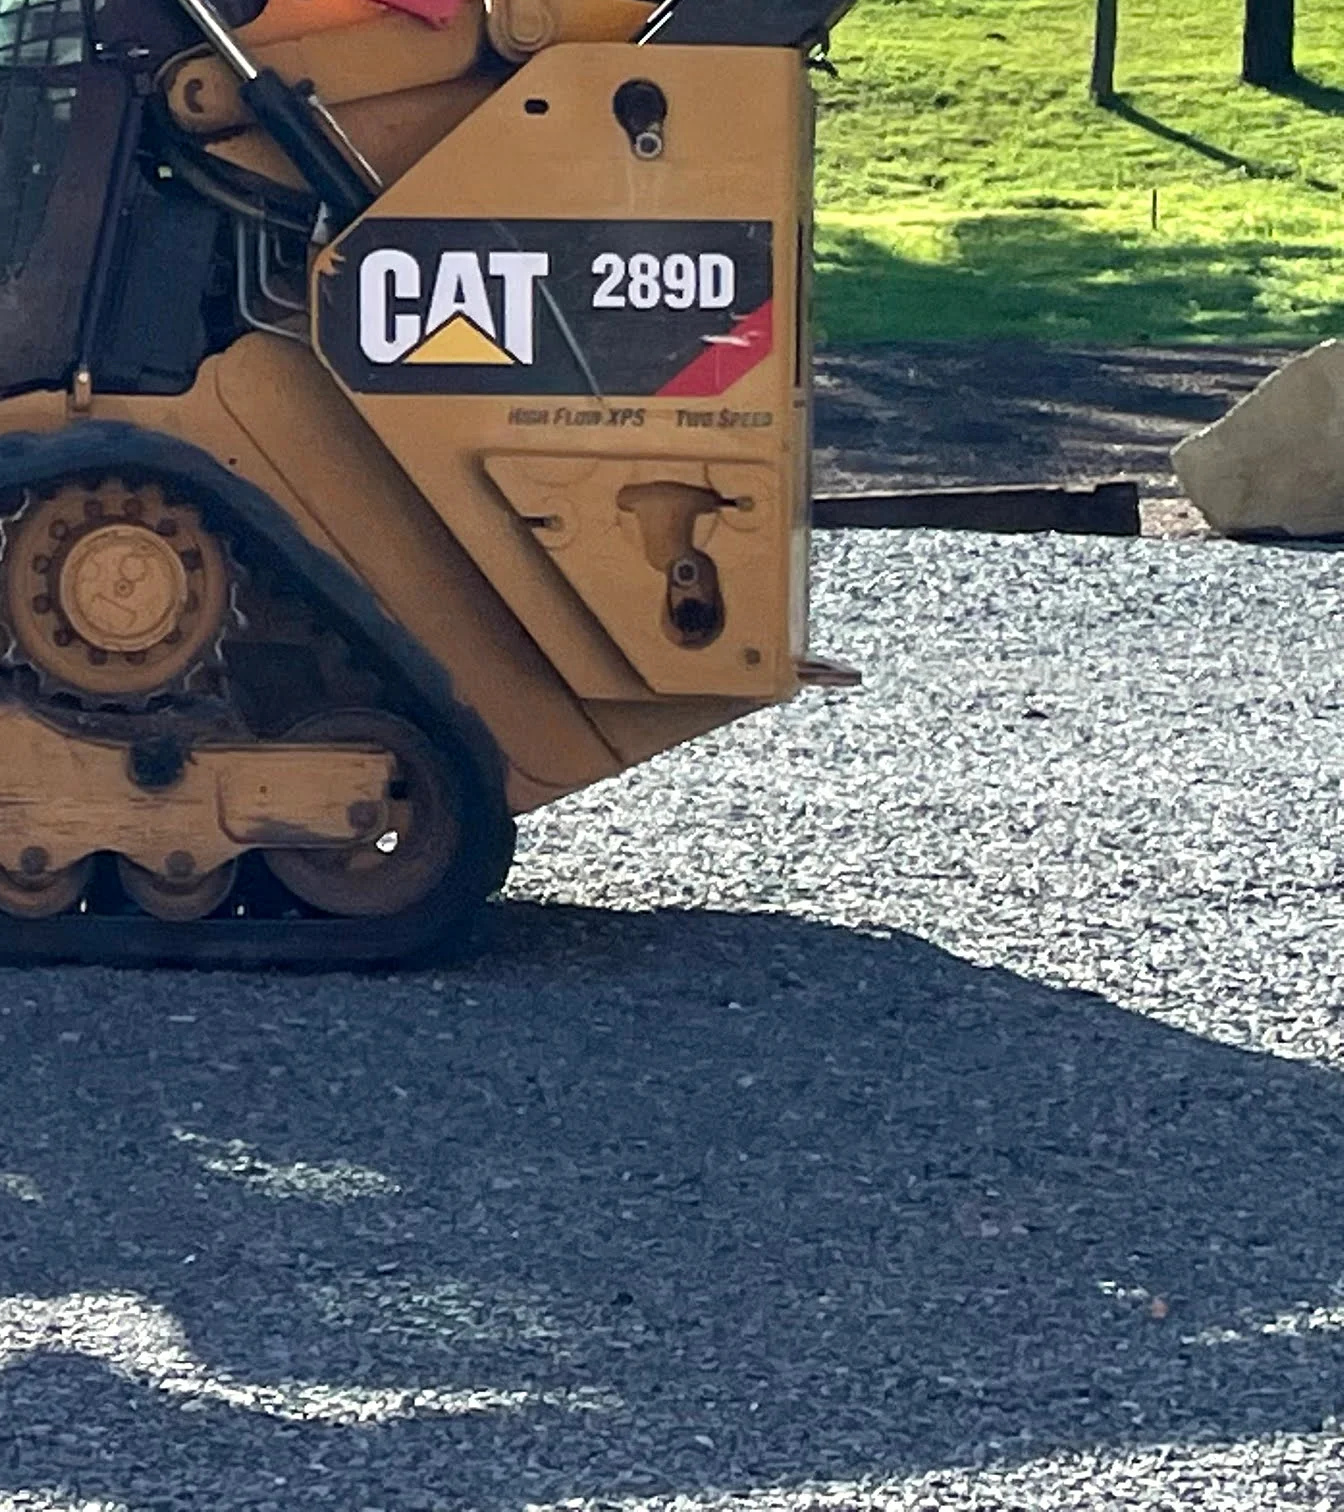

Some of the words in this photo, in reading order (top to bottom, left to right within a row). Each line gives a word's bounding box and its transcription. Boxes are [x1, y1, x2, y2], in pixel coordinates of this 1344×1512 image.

[359, 248, 549, 365] CAT
[592, 253, 735, 309] 289D
[608, 407, 647, 427] XPS
[719, 408, 774, 429] SPEED
